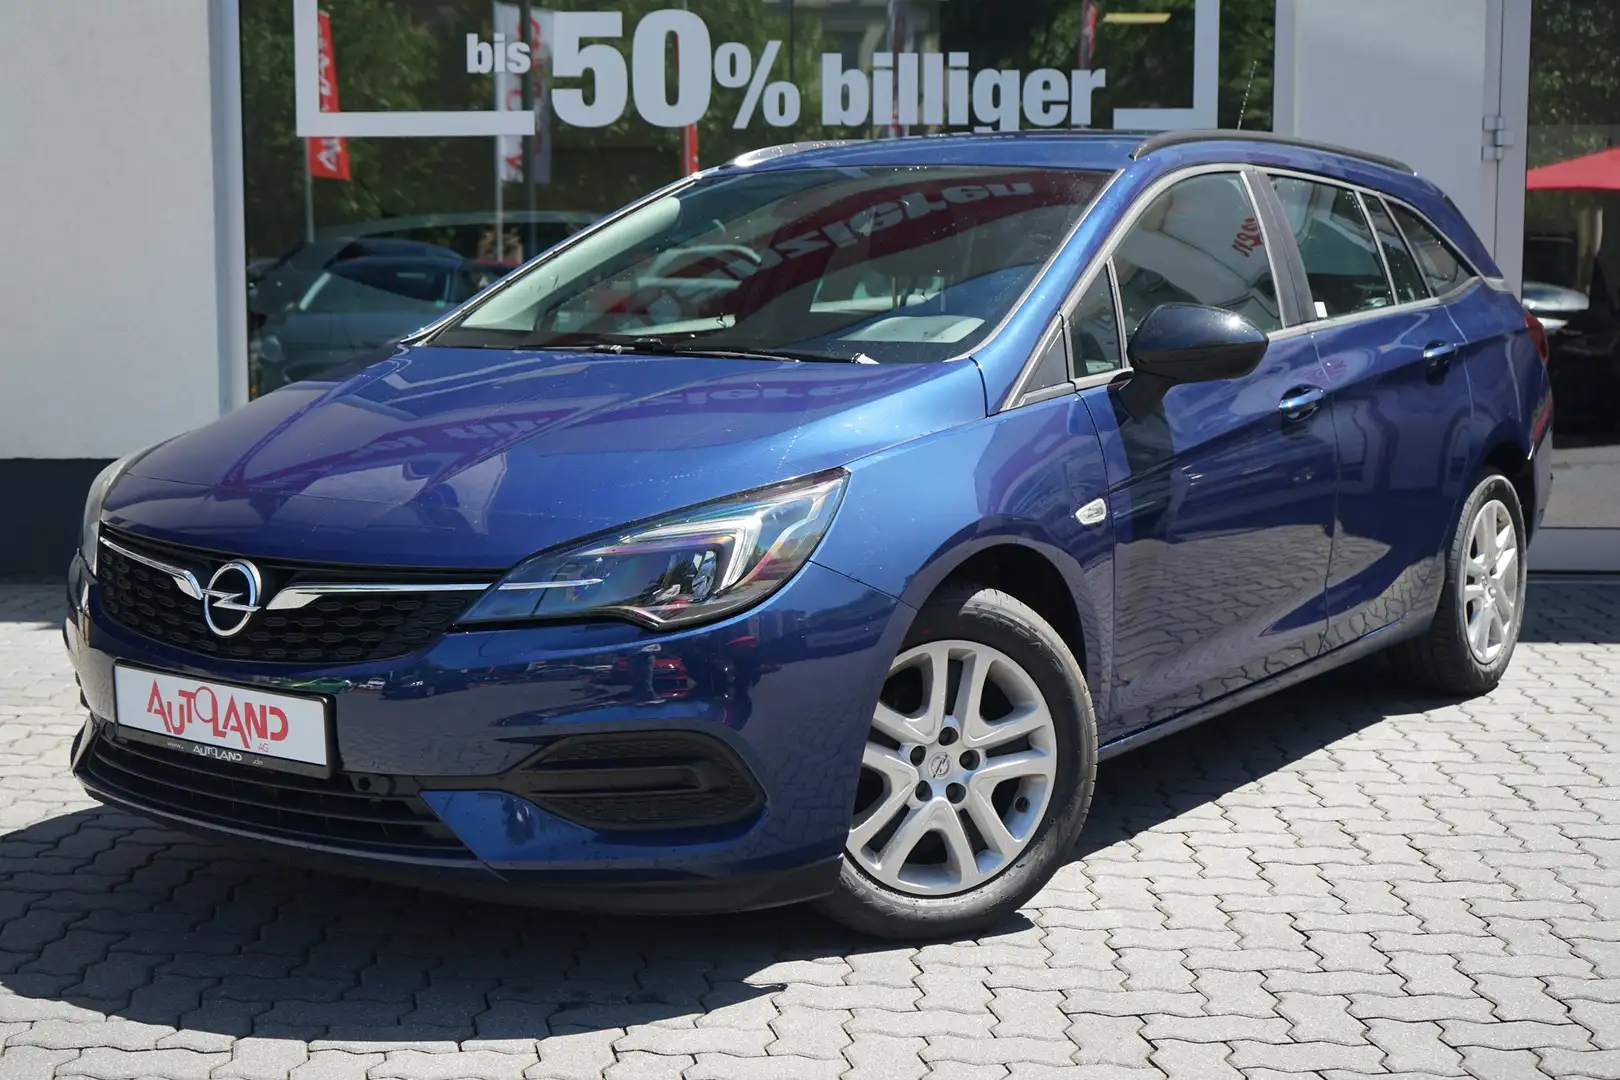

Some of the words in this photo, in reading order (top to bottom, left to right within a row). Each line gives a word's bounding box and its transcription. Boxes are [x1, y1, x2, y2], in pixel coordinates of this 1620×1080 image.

[466, 33, 531, 74] bis
[551, 9, 801, 129] 50%
[821, 51, 1107, 130] billiger
[146, 679, 289, 749] AUTOLAND
[192, 744, 243, 762] AUTOLAND
[257, 742, 270, 753] AG
